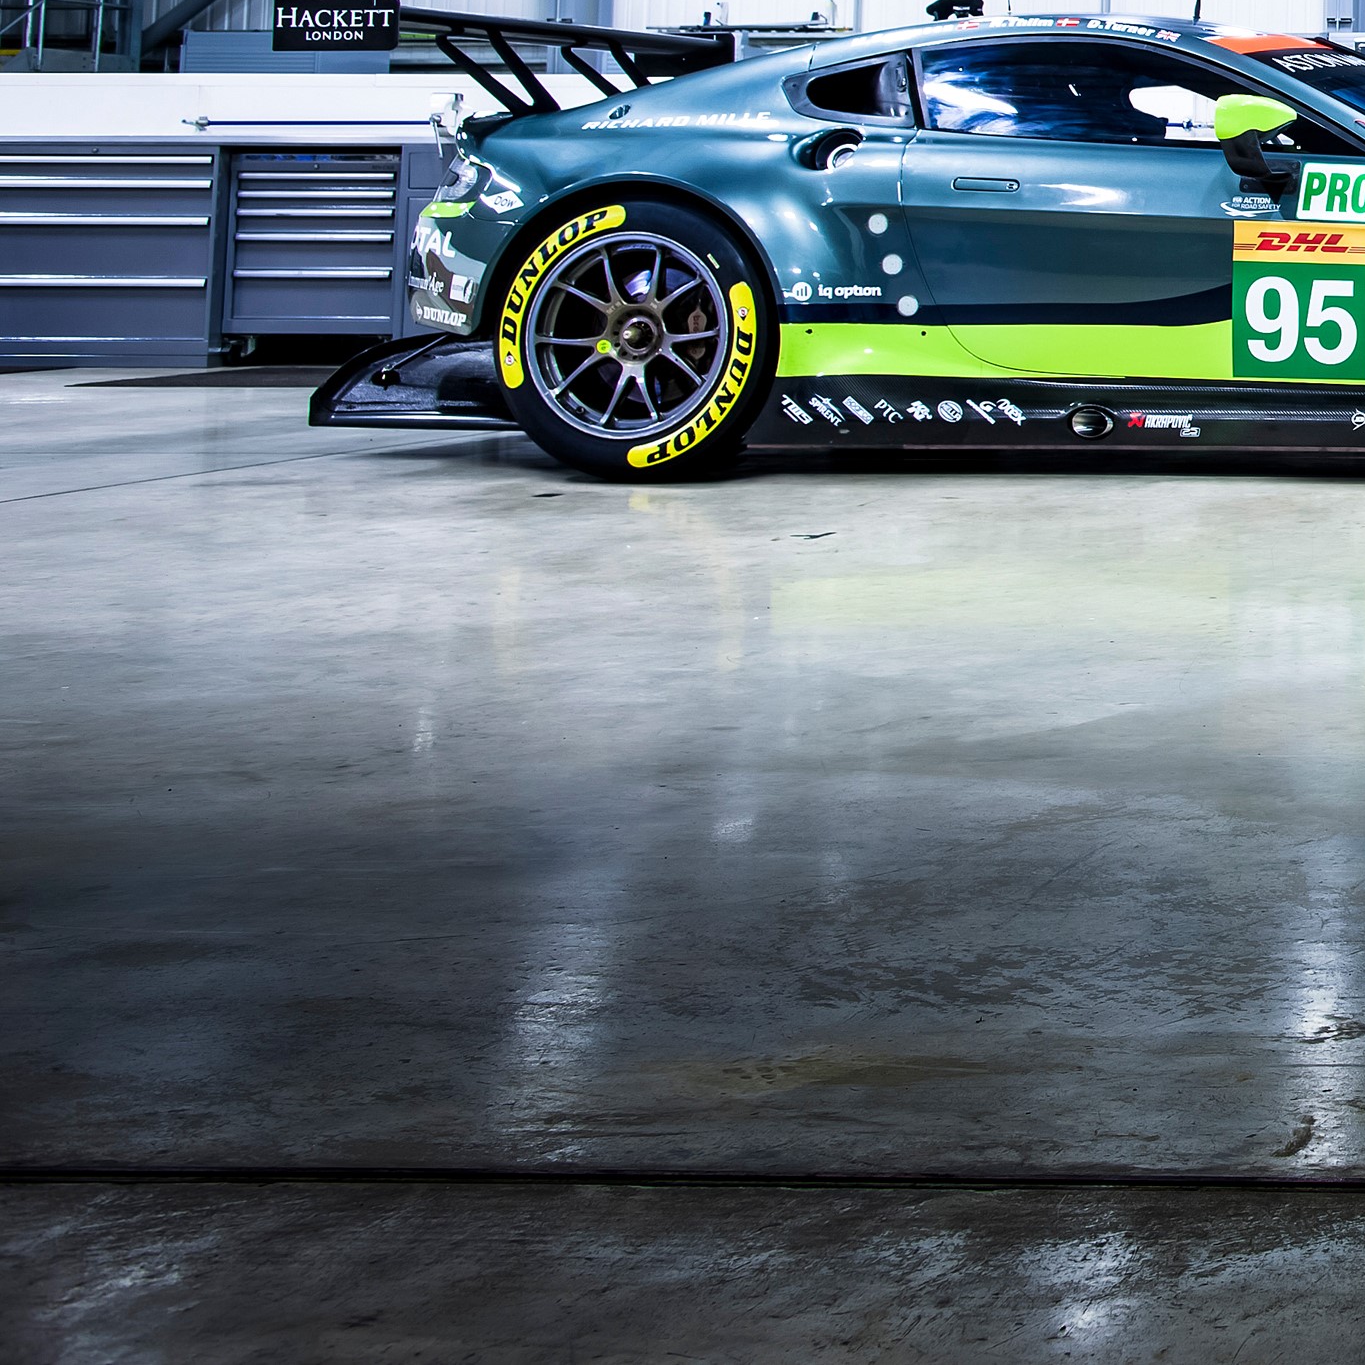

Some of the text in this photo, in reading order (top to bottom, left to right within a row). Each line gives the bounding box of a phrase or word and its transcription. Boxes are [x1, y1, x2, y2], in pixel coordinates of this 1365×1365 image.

[276, 7, 394, 28] HACKETT
[305, 31, 364, 41] LONDON
[581, 116, 690, 130] RICHARD
[1255, 232, 1349, 252] DHL
[502, 210, 608, 346] DUNLOP
[818, 284, 832, 299] iq
[423, 306, 467, 327] DUNLOP
[1245, 276, 1358, 365] 95
[646, 326, 753, 464] DUNLOP
[808, 397, 843, 427] SPIRENT
